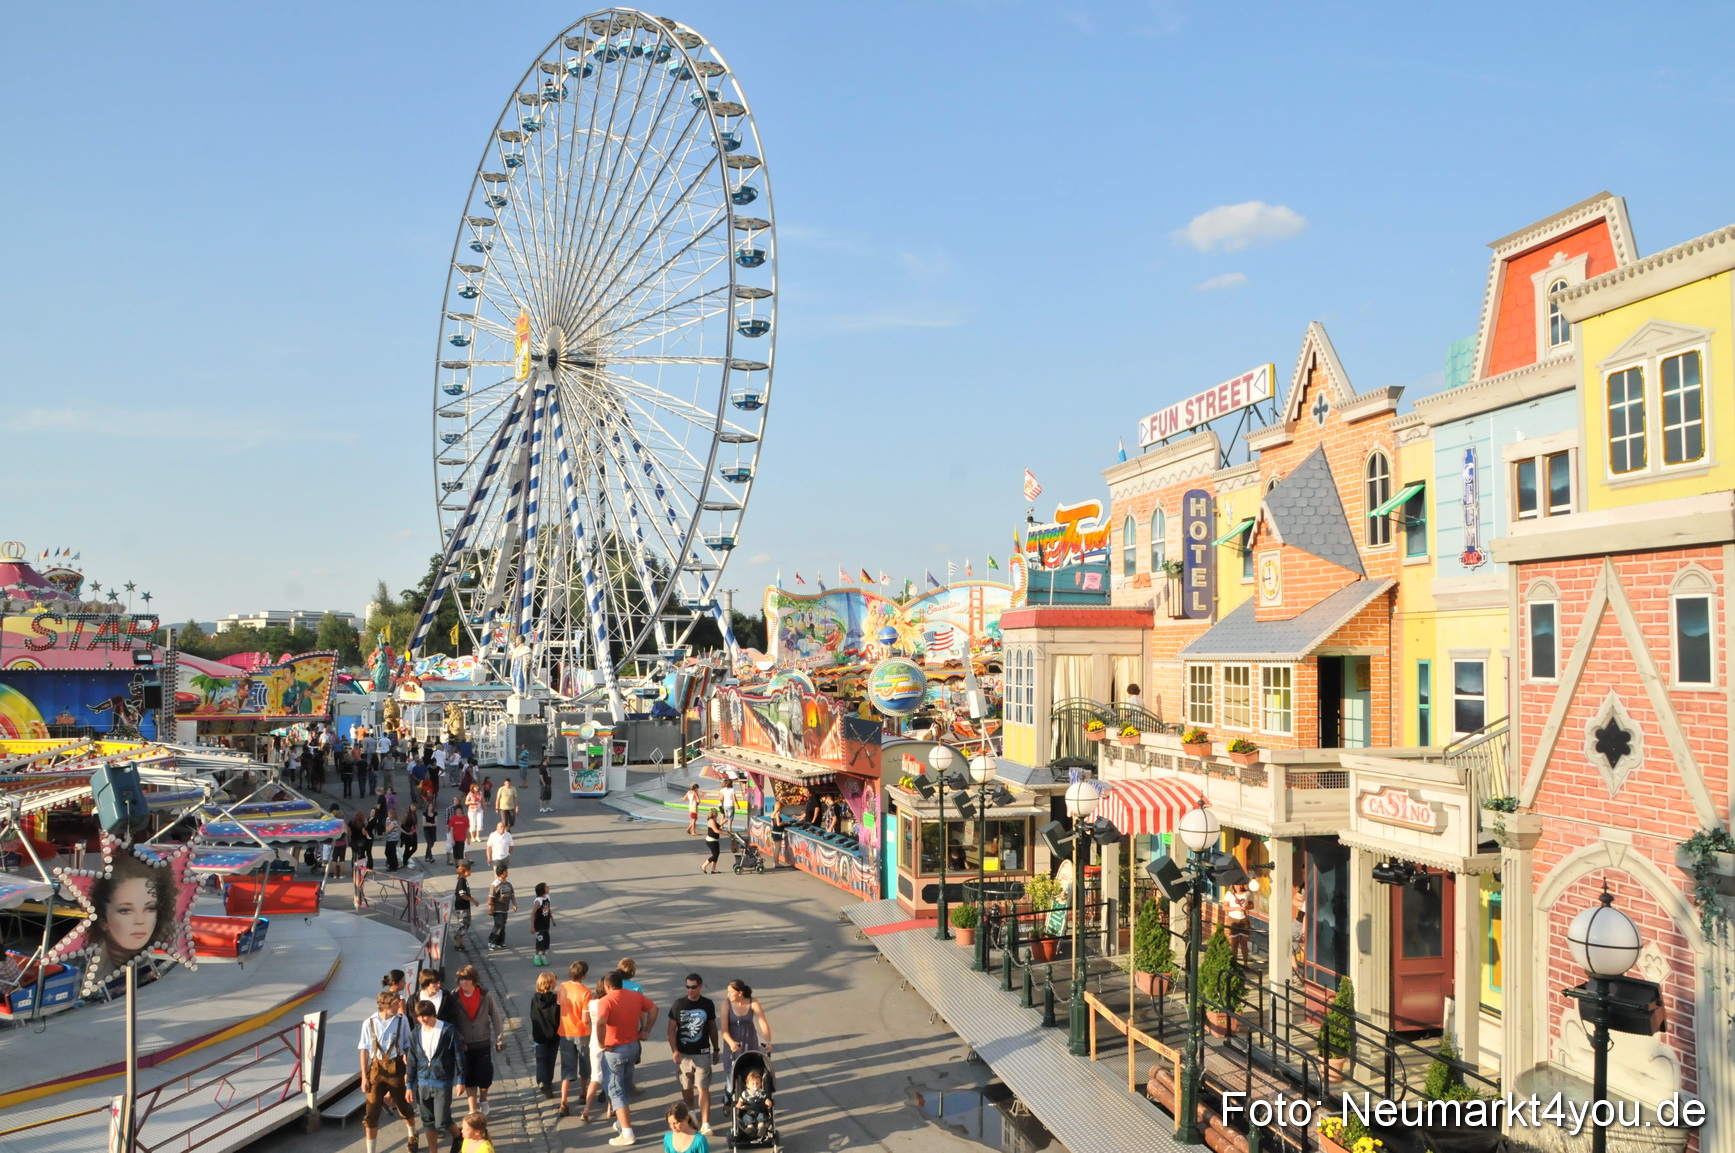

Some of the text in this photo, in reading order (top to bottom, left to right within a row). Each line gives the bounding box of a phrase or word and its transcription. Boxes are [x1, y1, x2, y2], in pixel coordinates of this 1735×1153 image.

[1150, 372, 1254, 441] FUN STREET
[1189, 497, 1208, 611] HOTEL
[927, 601, 961, 615] Sausalito
[23, 611, 160, 651] STAR
[1369, 792, 1431, 824] CASINO
[27, 989, 33, 999] 1
